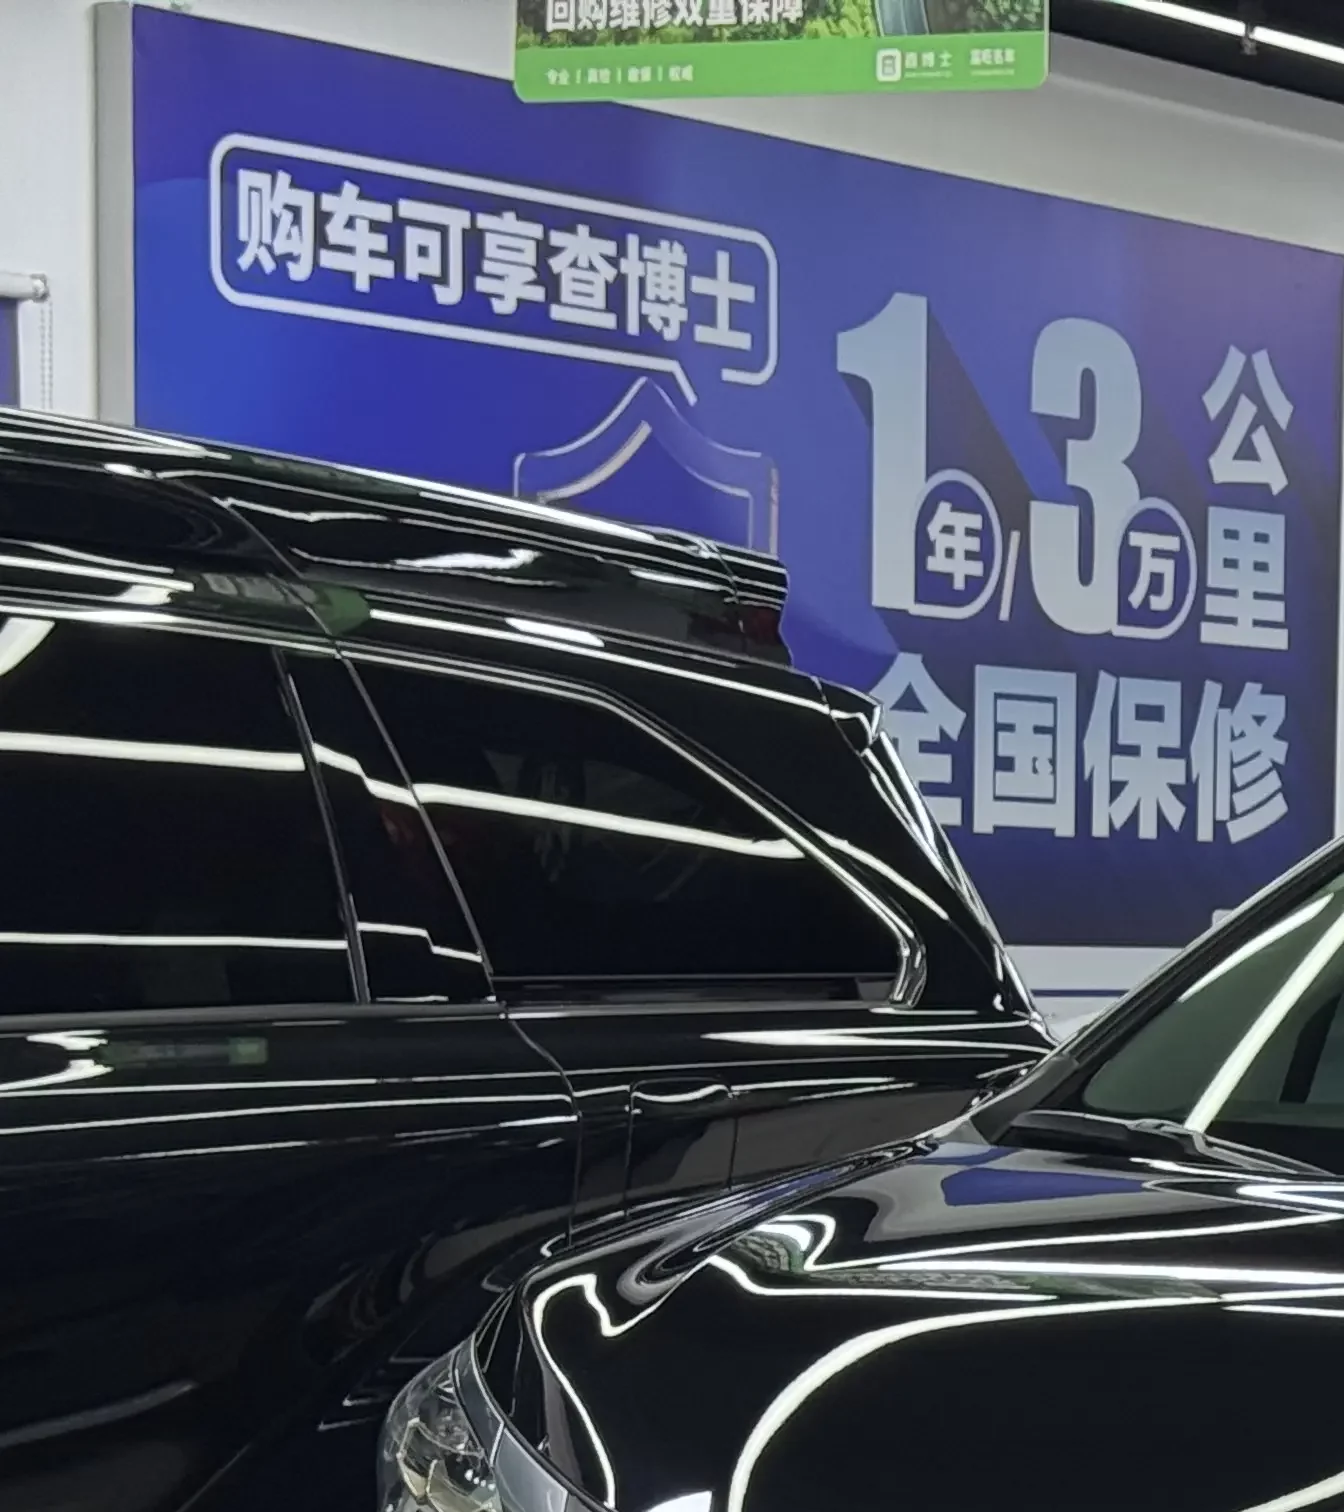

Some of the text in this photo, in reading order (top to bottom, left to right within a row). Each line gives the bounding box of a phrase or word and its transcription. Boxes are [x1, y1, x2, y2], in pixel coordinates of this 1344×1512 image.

[546, 0, 804, 32] 回购维修双重保障
[236, 168, 757, 352] 购车可享查博士
[868, 652, 1290, 845] 全国保修
